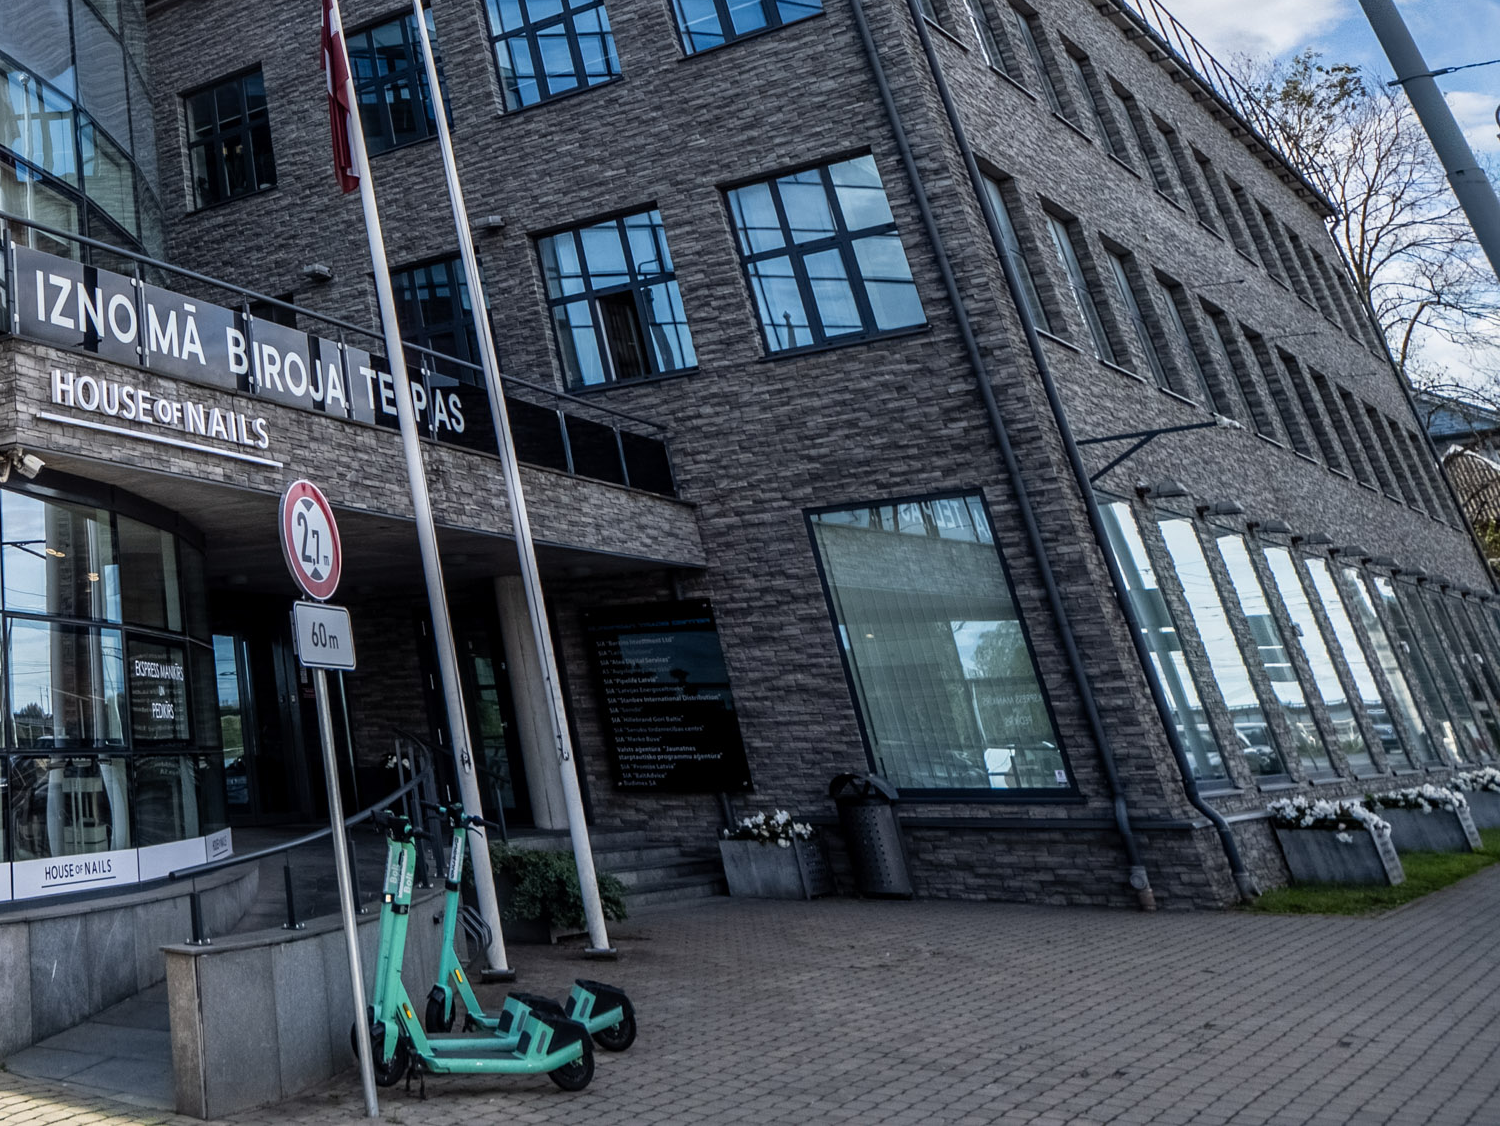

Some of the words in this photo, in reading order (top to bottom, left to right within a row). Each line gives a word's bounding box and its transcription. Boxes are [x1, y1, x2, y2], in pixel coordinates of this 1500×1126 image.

[36, 269, 206, 365] IZNOMĀ
[226, 326, 346, 408] BIROJA
[360, 365, 465, 434] TEPAS
[51, 369, 153, 424] HOUSE
[153, 398, 182, 425] OF
[182, 400, 270, 450] NAILS
[296, 510, 320, 566] 2,7
[643, 695, 681, 703] International
[45, 863, 74, 880] HOUSE
[84, 859, 112, 876] NAILS
[389, 864, 401, 884] Bolt
[403, 872, 414, 894] Bolt
